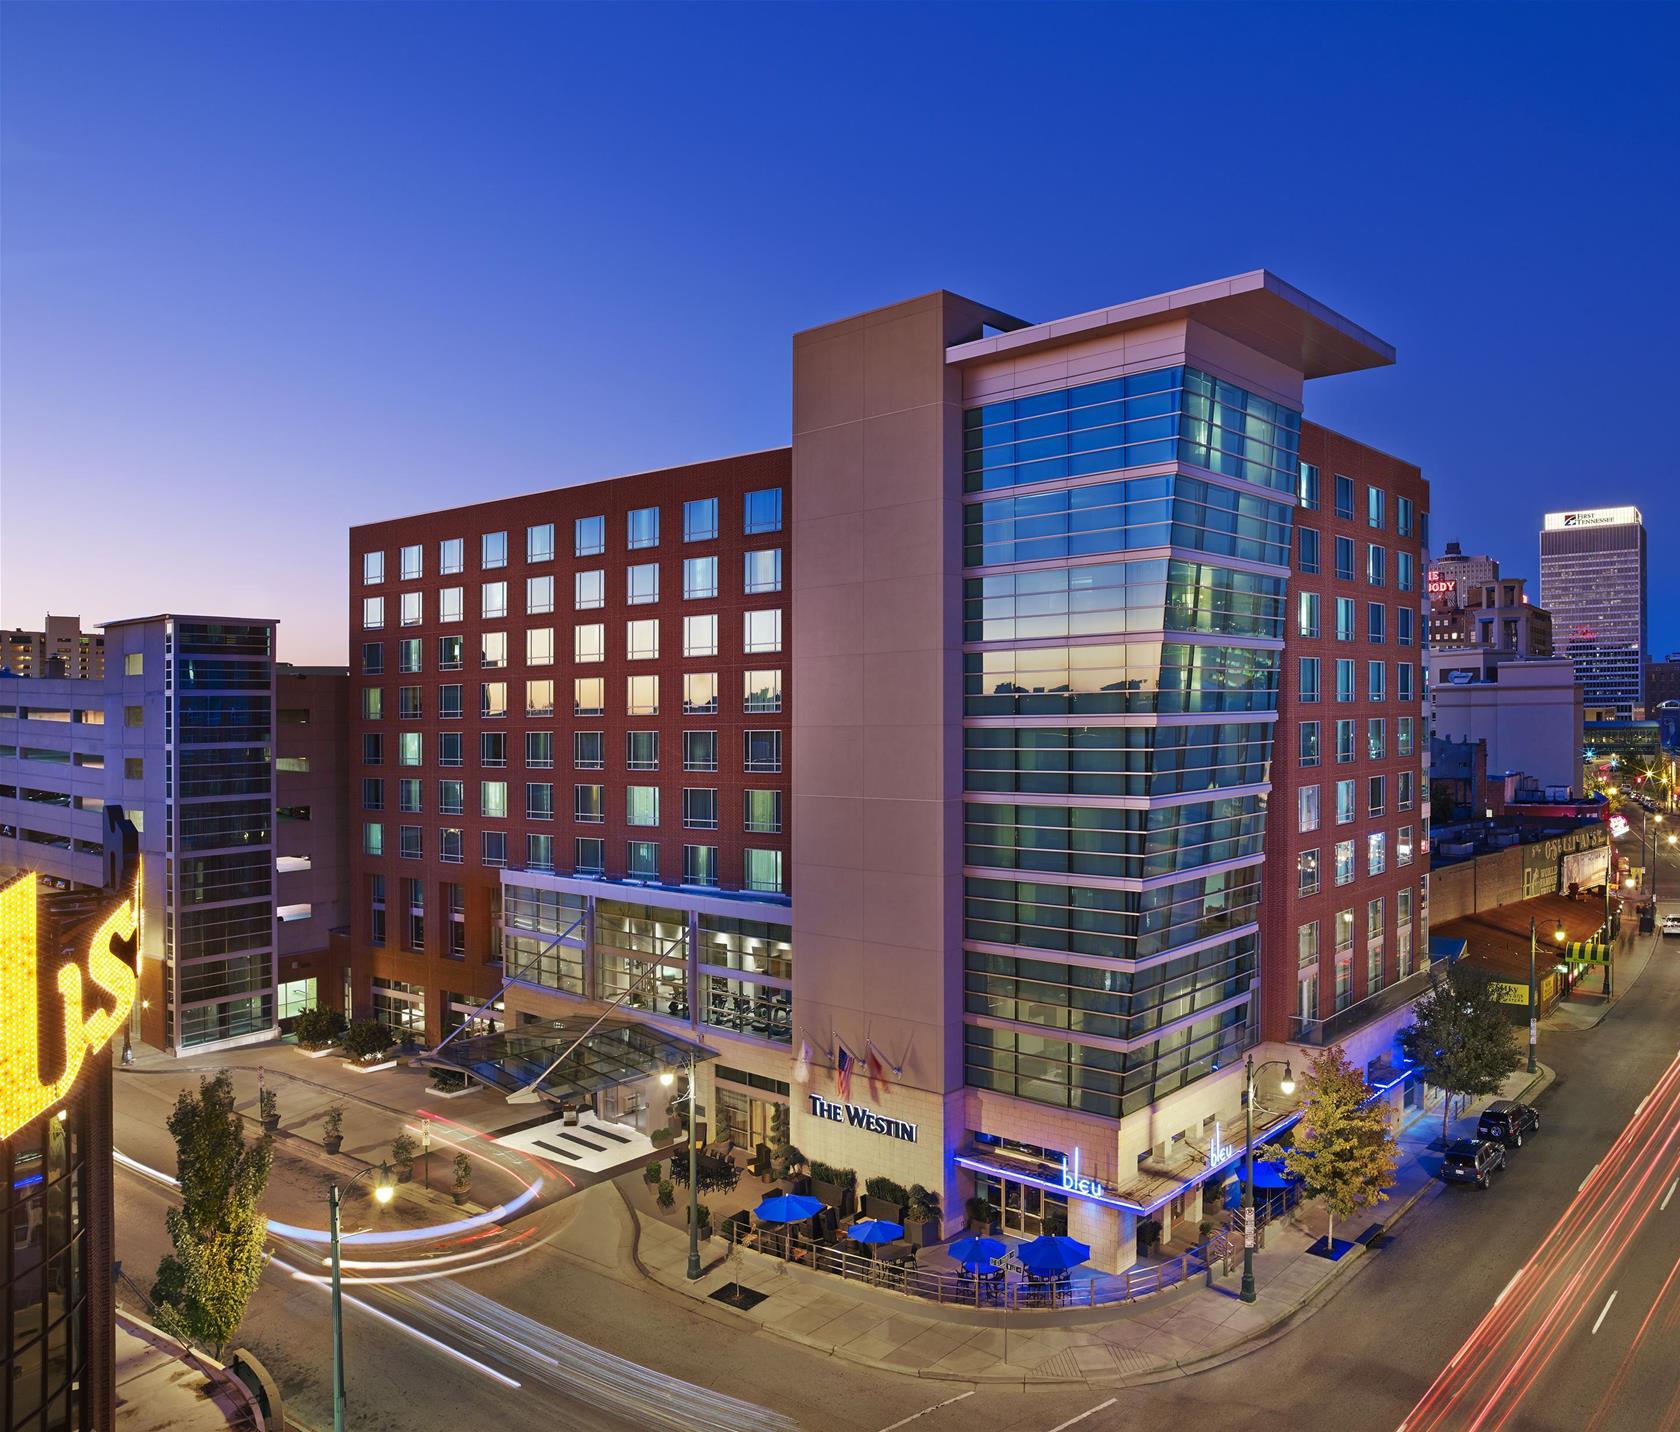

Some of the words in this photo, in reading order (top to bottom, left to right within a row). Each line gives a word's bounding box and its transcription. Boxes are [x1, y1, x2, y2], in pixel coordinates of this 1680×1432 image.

[1576, 517, 1614, 525] TENNESSEE
[1429, 581, 1456, 592] ODY
[808, 1092, 844, 1122] THE
[845, 1103, 918, 1144] WESTIN
[1209, 1121, 1232, 1168] bleu
[1062, 1146, 1102, 1197] bleu
